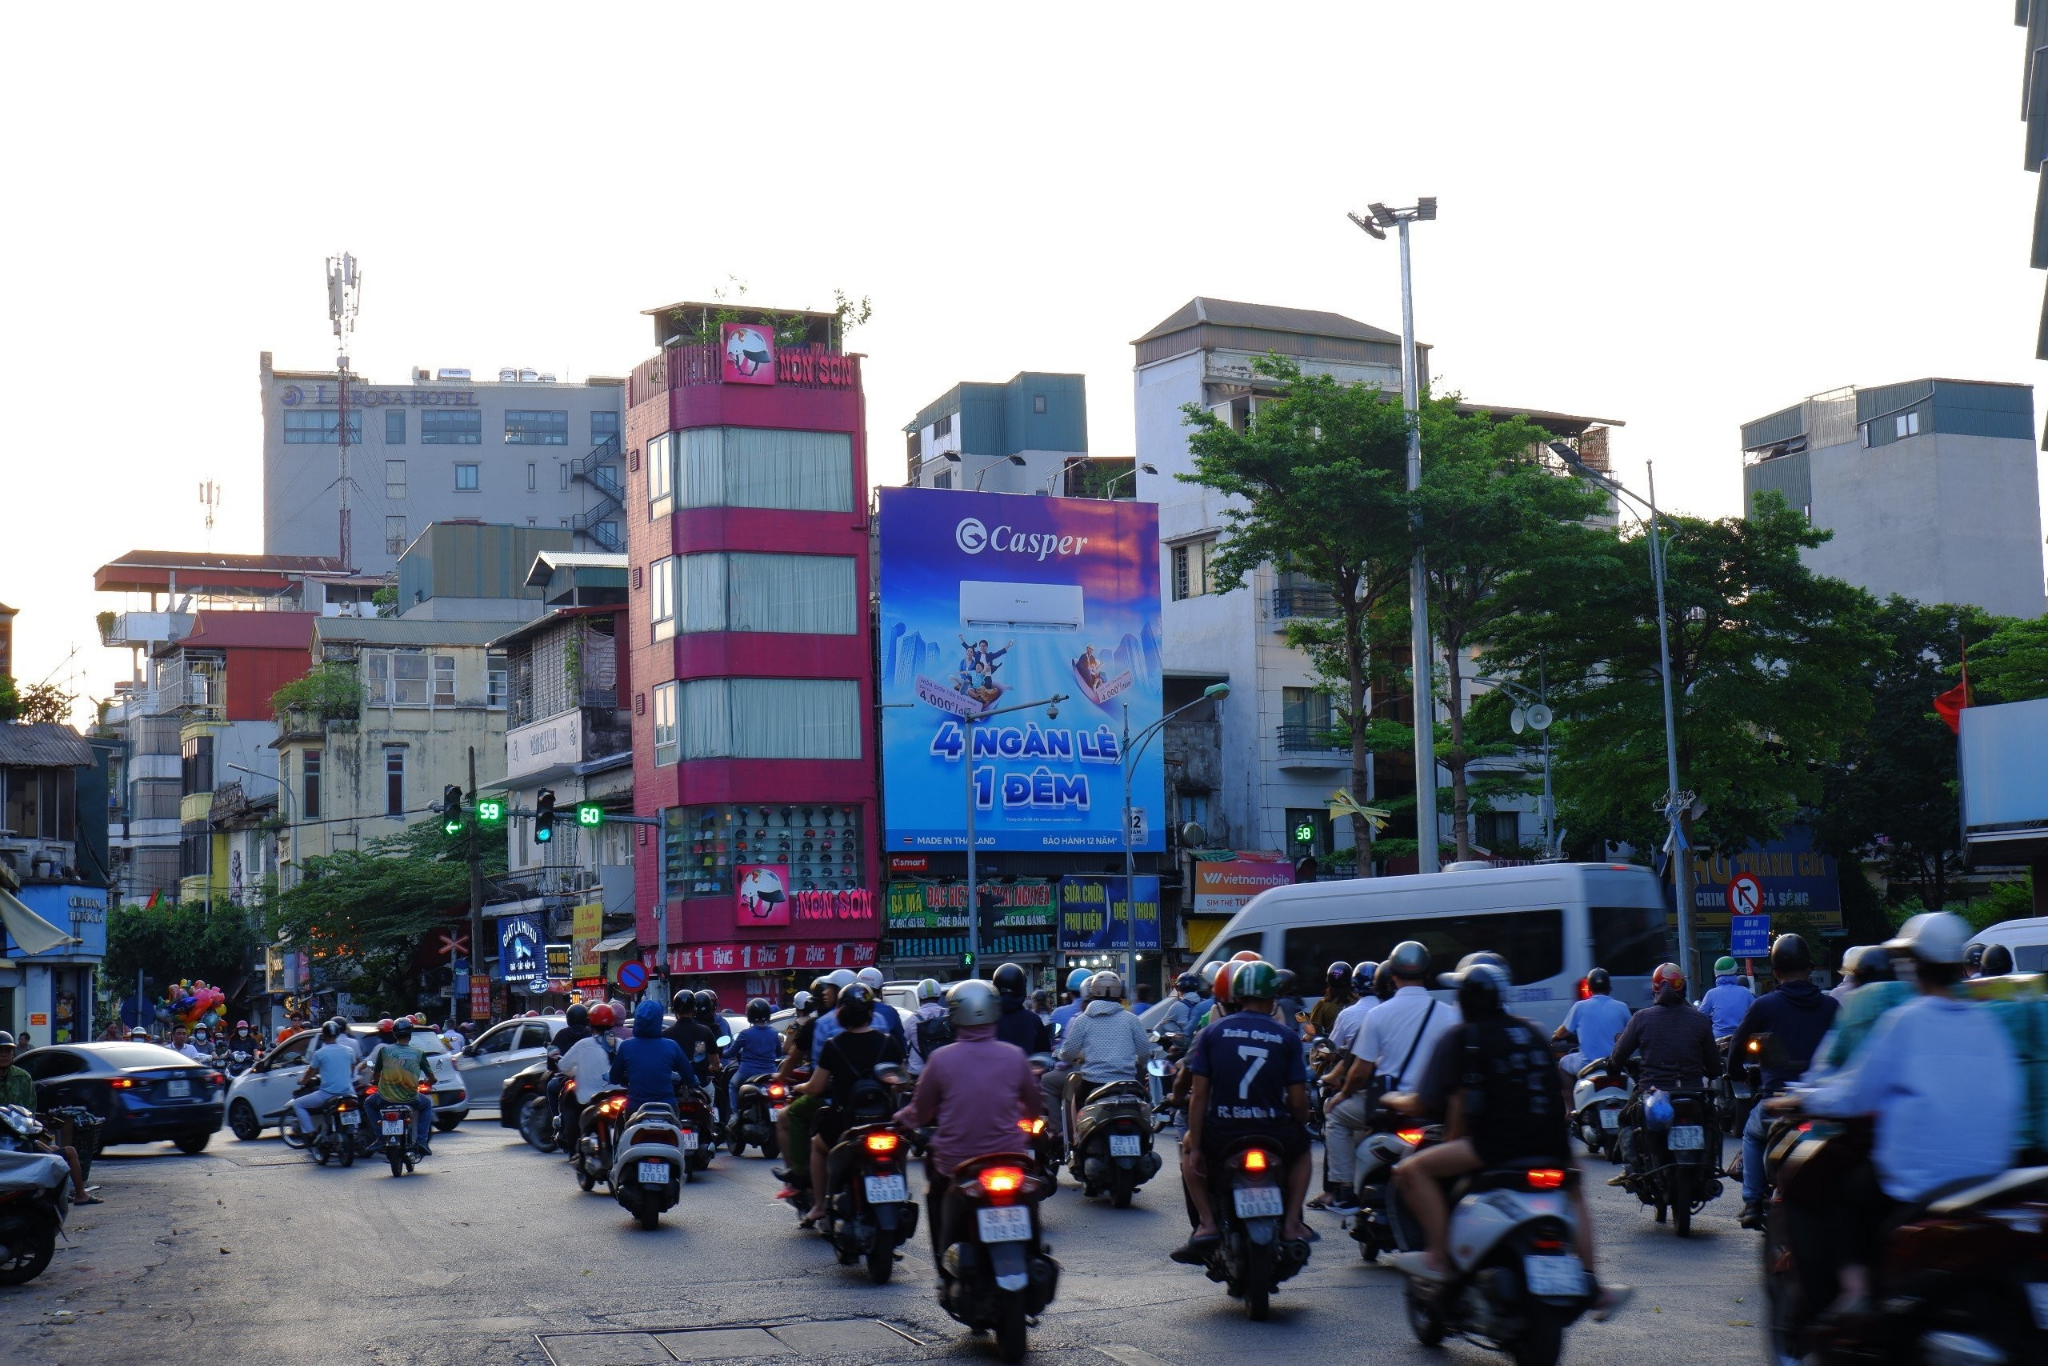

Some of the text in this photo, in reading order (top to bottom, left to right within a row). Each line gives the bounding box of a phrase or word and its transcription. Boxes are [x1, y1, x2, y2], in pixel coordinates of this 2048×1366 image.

[411, 390, 479, 406] HOTEL
[991, 526, 1088, 561] Casper
[931, 721, 1122, 764] 4 NGÀN LẺ
[973, 766, 1091, 810] 1 ĐÊM
[480, 803, 499, 820] 59
[580, 808, 599, 824] 60
[917, 837, 995, 845] MADE IN THAND
[1043, 835, 1060, 845] BẢO
[1062, 835, 1085, 845] HÀNH
[1297, 827, 1311, 839] 58
[1223, 873, 1290, 885] vietnamobile
[926, 885, 947, 912] ĐẶC
[1064, 880, 1105, 903] SỬA CHỮA
[1696, 892, 1726, 906] CHIM
[1010, 915, 1026, 926] CAO
[1133, 902, 1158, 925] THOẠI
[1064, 909, 1102, 935] PHỤ KIỆN
[695, 948, 703, 969] 1
[713, 947, 733, 968] TẶNG
[741, 946, 751, 968] 1
[757, 946, 777, 966] TẶNG
[785, 945, 795, 965] 1
[805, 944, 825, 965] TẶNG
[833, 944, 843, 965] 1
[854, 943, 873, 964] TẶNG
[746, 979, 771, 994] BUY
[1237, 1045, 1269, 1099] 7
[643, 1163, 665, 1173] 29-E1
[641, 1172, 667, 1182] 920.29
